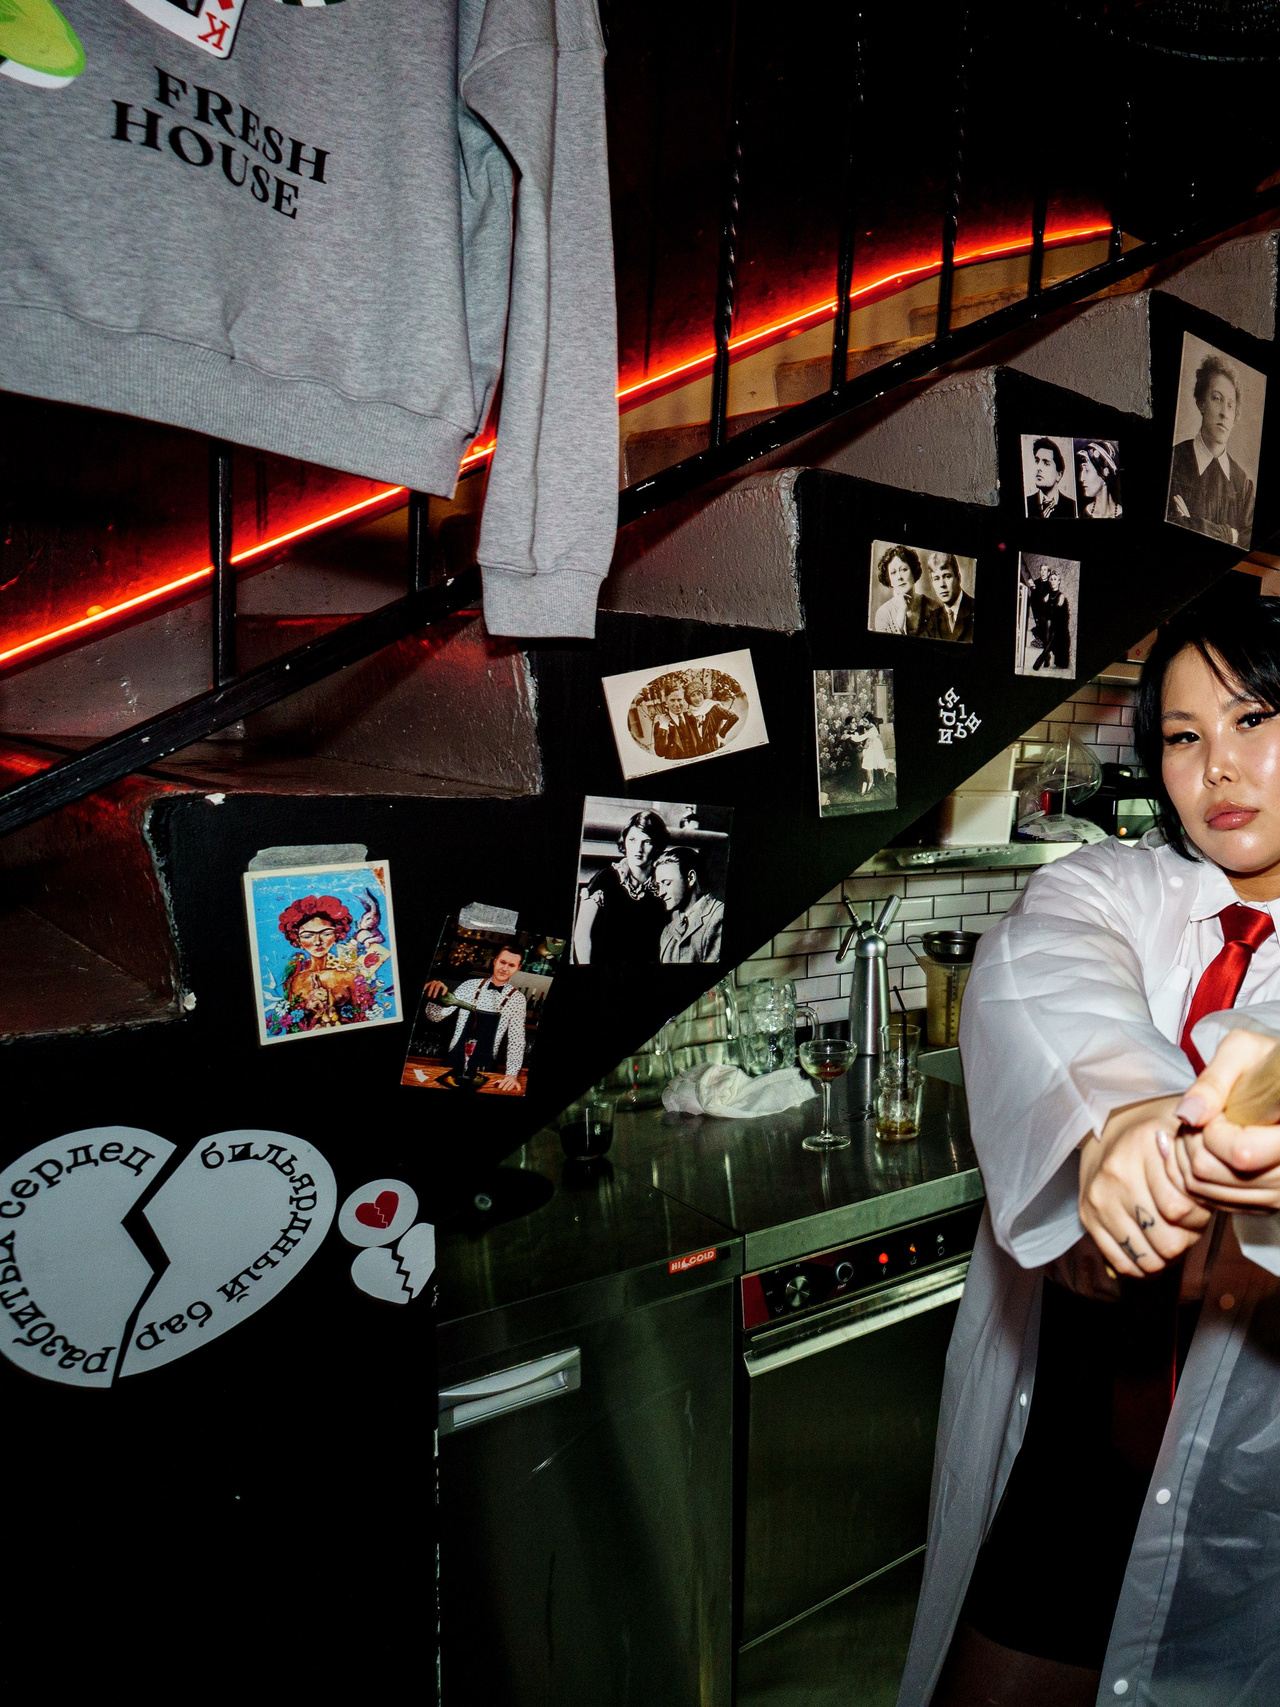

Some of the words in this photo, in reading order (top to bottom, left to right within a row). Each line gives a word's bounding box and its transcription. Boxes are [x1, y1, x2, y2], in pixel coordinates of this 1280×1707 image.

[111, 99, 299, 220] HOUSE
[154, 65, 331, 185] FRESH
[689, 1249, 715, 1266] COLD
[135, 1300, 213, 1351] бар
